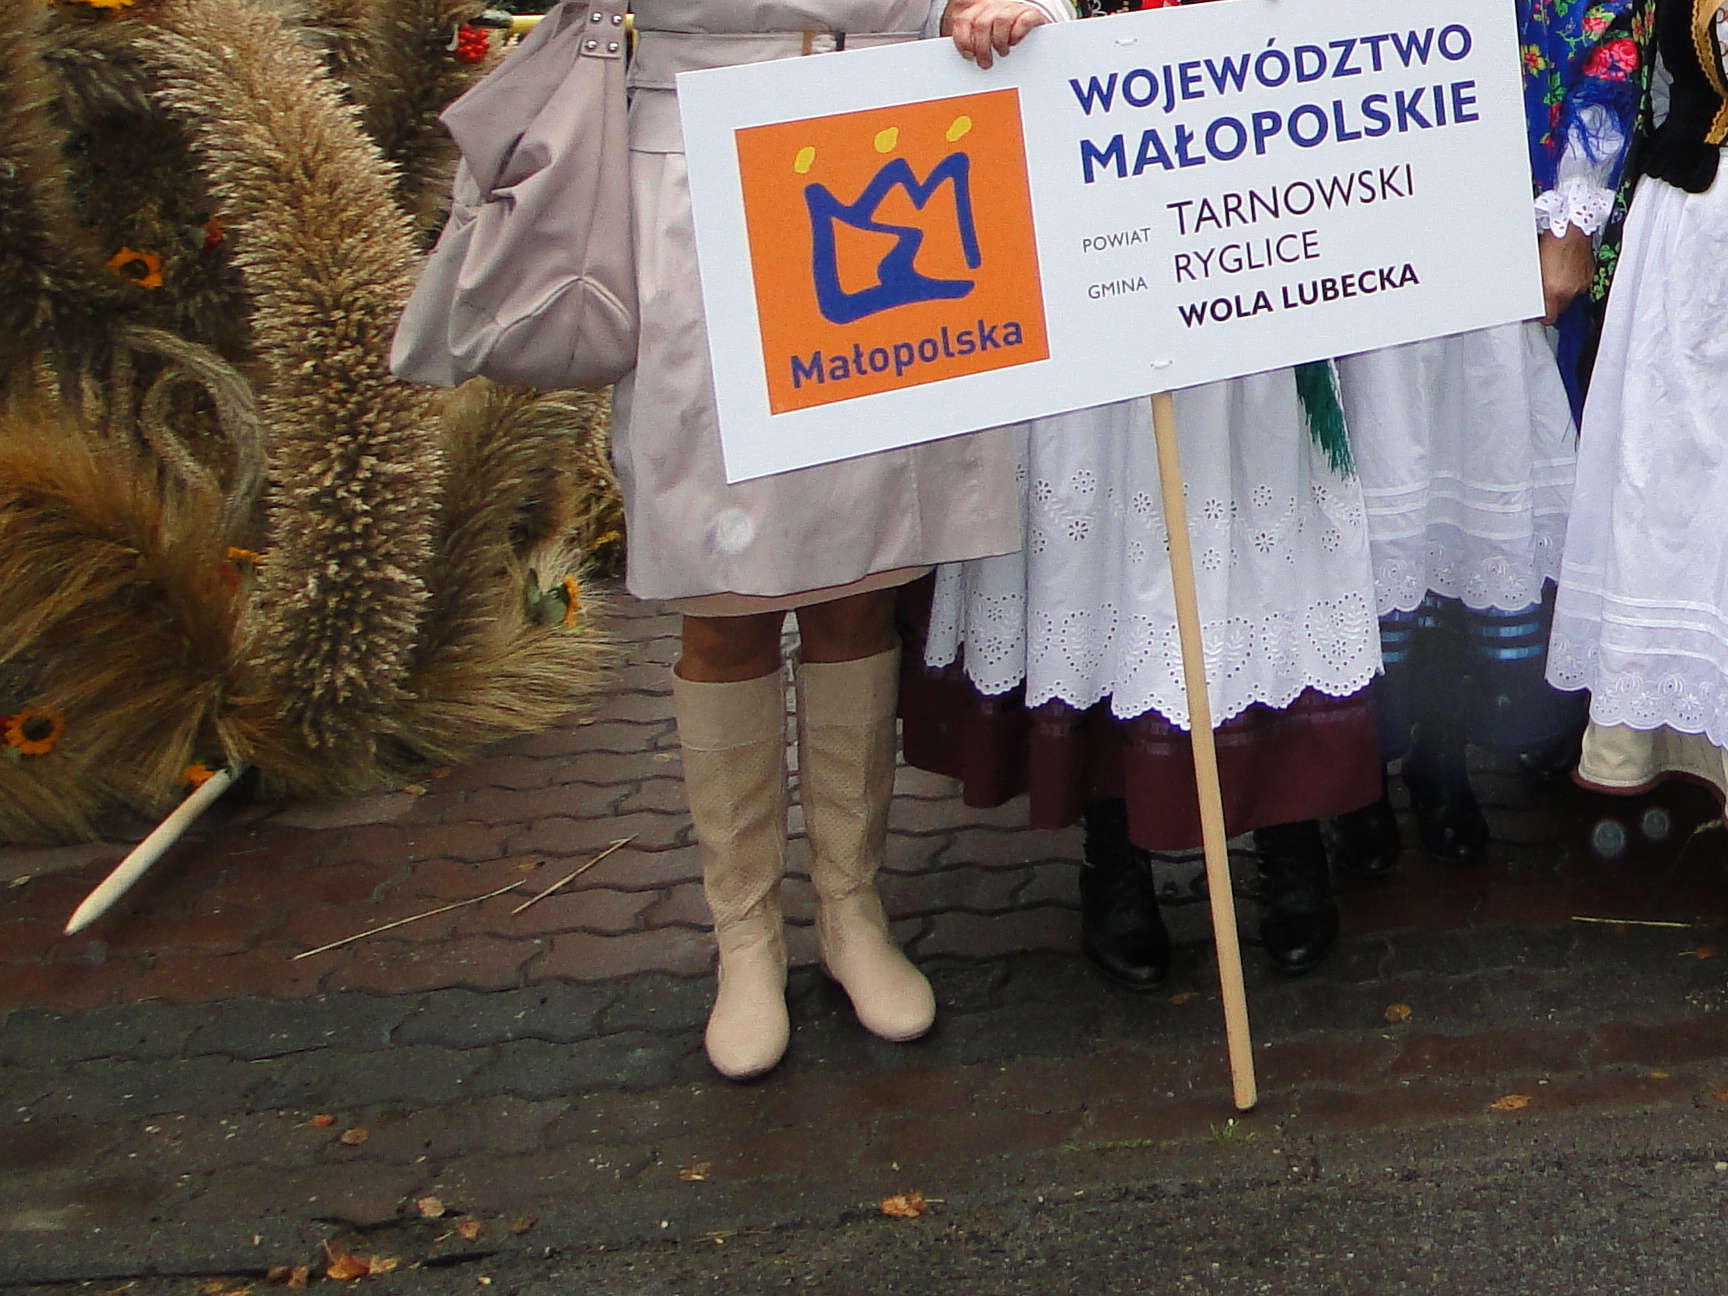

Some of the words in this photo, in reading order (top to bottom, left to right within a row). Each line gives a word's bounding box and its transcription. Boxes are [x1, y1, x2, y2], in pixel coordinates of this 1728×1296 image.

[1069, 24, 1471, 115] WOJEWÓDZTWO
[1080, 80, 1479, 184] MAŁOPOLSKIE
[1083, 228, 1150, 252] POWIAT
[1167, 164, 1413, 235] TARNOWSKI
[1089, 277, 1147, 299] GMINA
[1175, 230, 1320, 283] RYGLICE
[1178, 291, 1273, 328] WOLA
[1282, 264, 1419, 309] LUBECKA
[790, 319, 1022, 388] Małopolska
